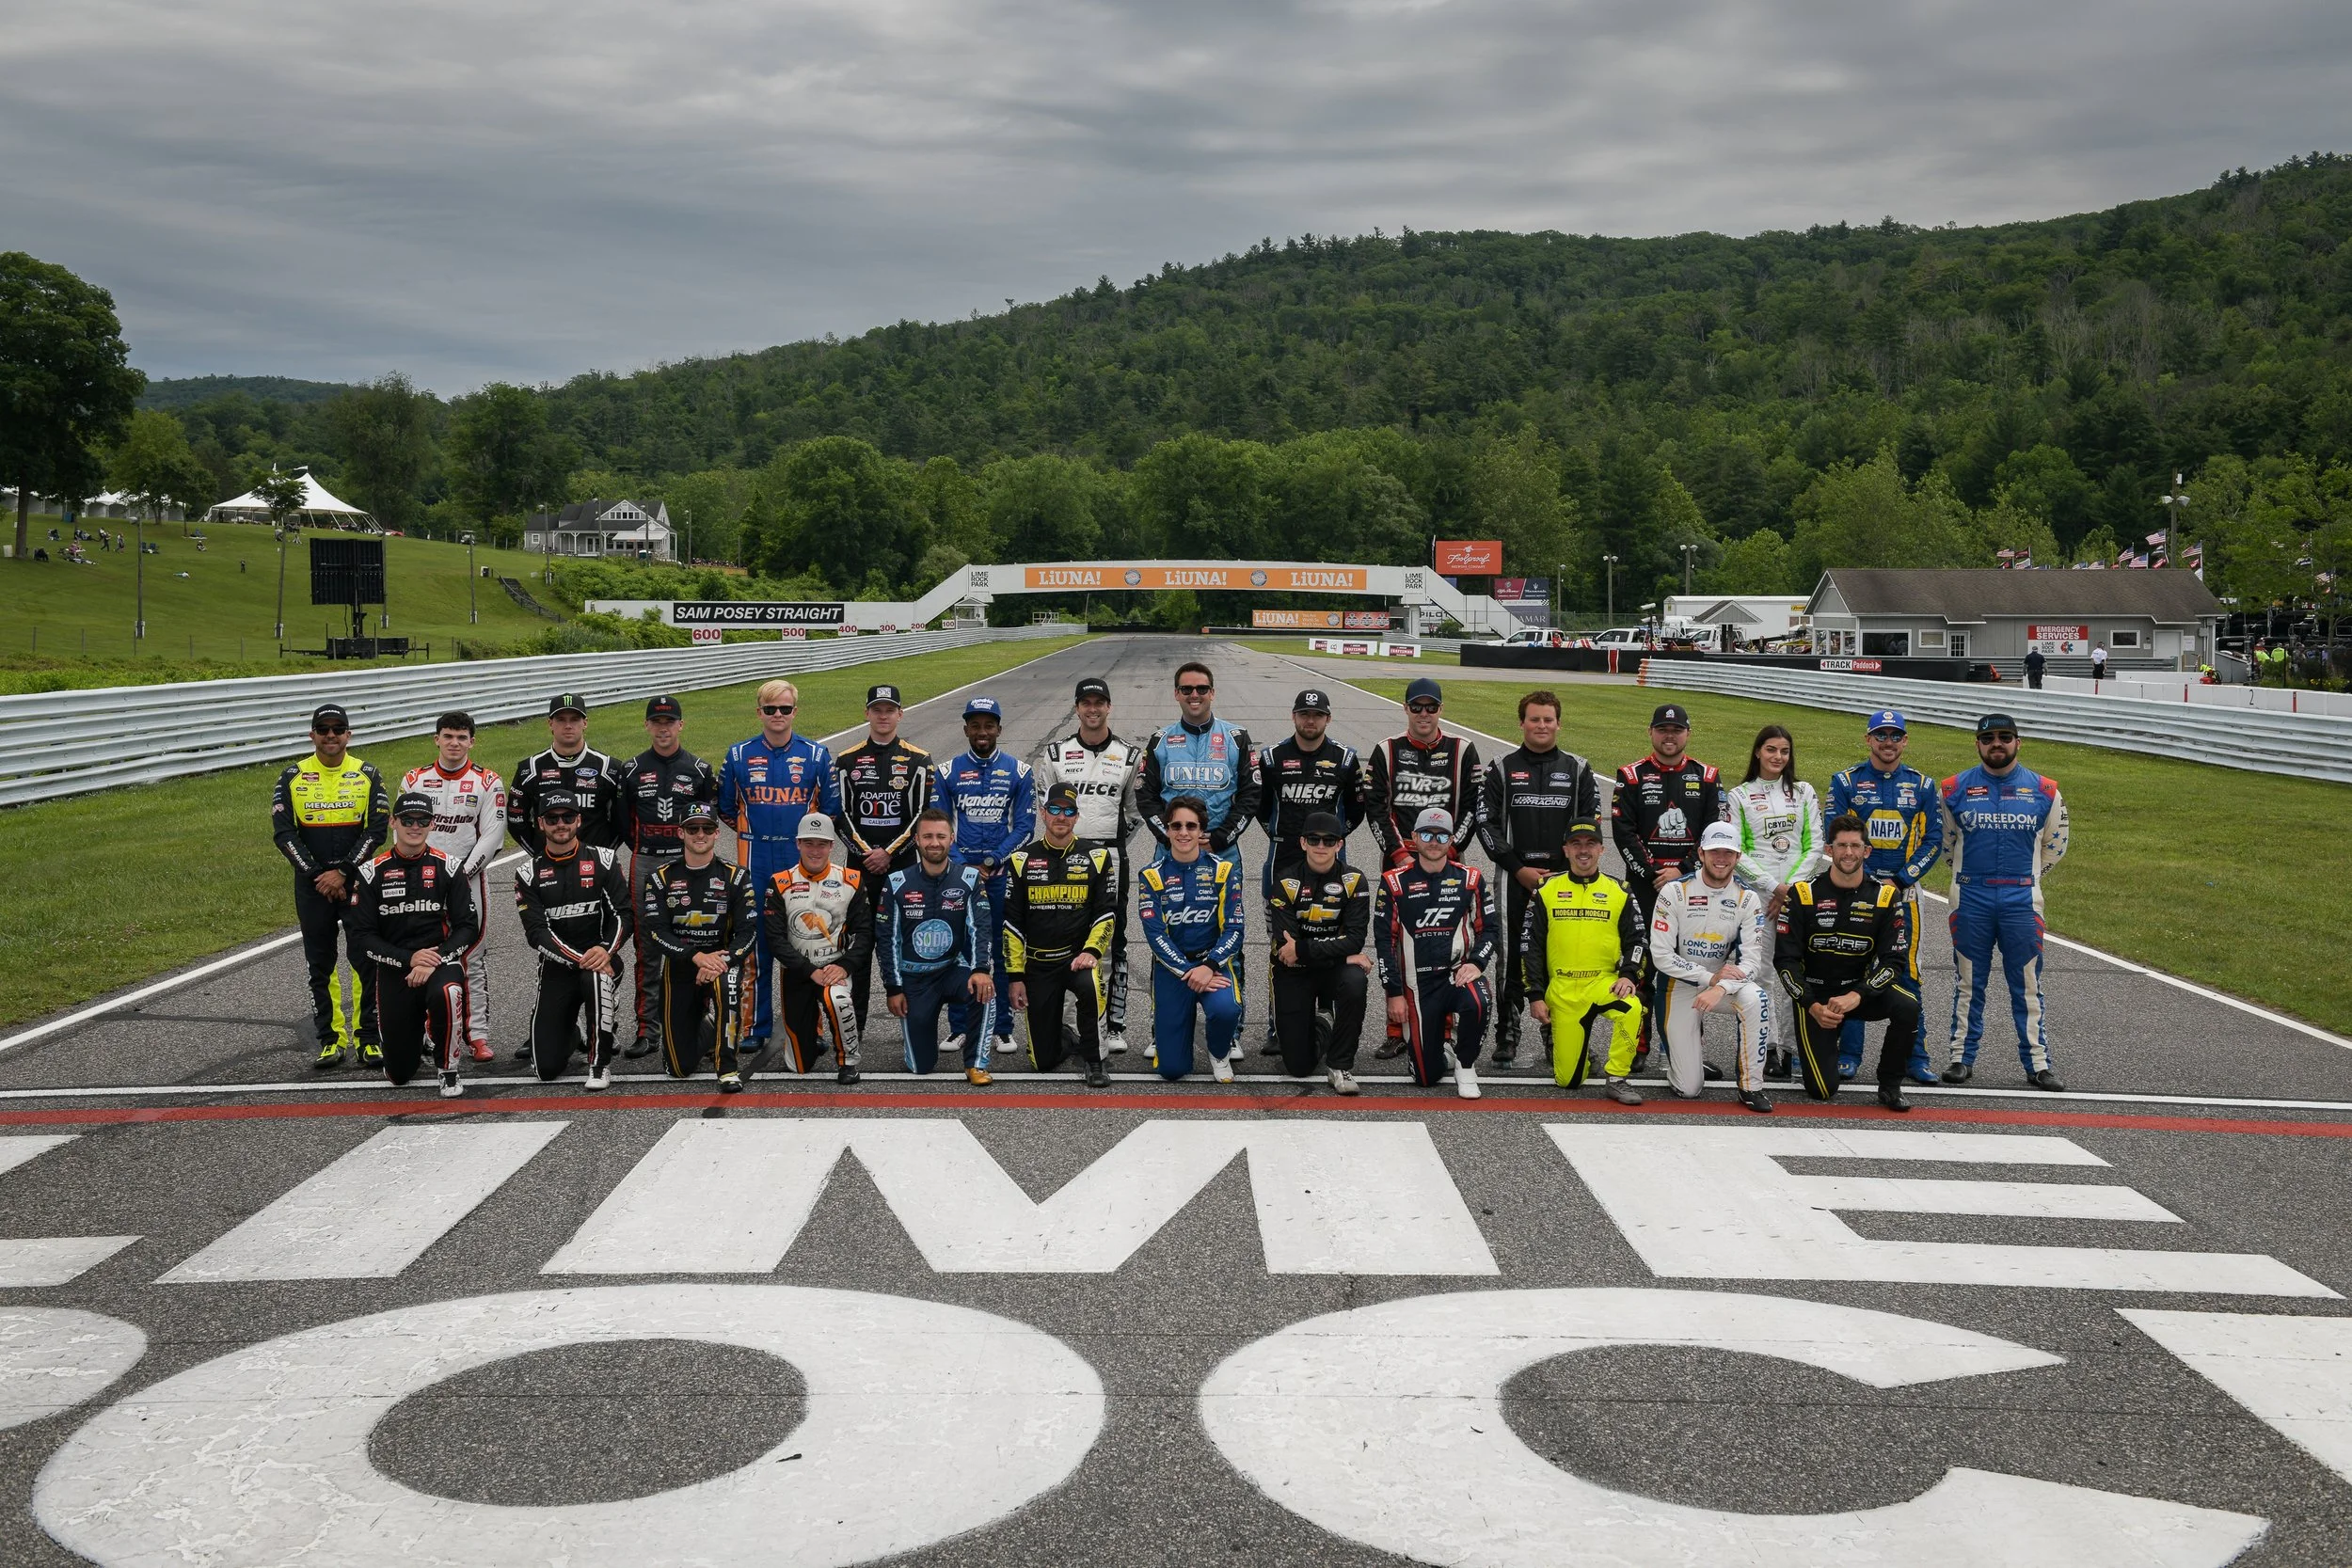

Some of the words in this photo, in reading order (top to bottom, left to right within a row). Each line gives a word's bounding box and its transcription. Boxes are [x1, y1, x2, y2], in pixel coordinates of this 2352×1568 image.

[1447, 554, 1490, 564] Foolproof
[1039, 571, 1101, 585] LiUNA!
[1165, 571, 1227, 586] LiUNA!
[1291, 572, 1353, 587] LiUNA!
[675, 607, 711, 619] SAM
[713, 607, 764, 620] POSEY
[765, 607, 842, 620] STRAIGHT
[1255, 612, 1299, 624] LiUNA!
[692, 629, 722, 641] 600
[782, 628, 805, 637] 500
[838, 625, 858, 634] 400
[2249, 689, 2254, 705] 2
[1169, 767, 1224, 782] UNITS
[1281, 784, 1337, 799] NIECE
[1411, 777, 1432, 792] VR
[546, 794, 572, 807] Tricon
[745, 785, 809, 802] LiUNA!
[860, 792, 901, 800] ADAPTIVE
[860, 800, 901, 816] one
[957, 794, 1010, 810] Hendrick
[433, 814, 453, 824] First
[453, 814, 474, 824] Auto
[966, 807, 1004, 817] Cars.com
[1978, 813, 2037, 825] FREEDOM
[1768, 821, 1786, 829] CBYD
[1871, 820, 1901, 838] NAPA
[287, 840, 310, 871] MENARDS
[1622, 847, 1646, 878] BRAWL
[1918, 857, 1931, 867] AUTO
[1028, 886, 1088, 900] CHAMPION
[379, 899, 441, 916] Safelite
[1723, 900, 1737, 908] Ford
[1166, 904, 1218, 925] telcel
[1585, 910, 1609, 919] MORGAN
[916, 931, 949, 947] SODA
[1683, 939, 1707, 949] LONG
[1813, 936, 1868, 948] SPIRE
[366, 950, 402, 968] Safelite
[1687, 948, 1725, 959] SILVER'S
[1110, 960, 1128, 1024] NIECE
[1756, 989, 1770, 1023] JOHN
[1757, 1028, 1768, 1064] LONG
[0, 1117, 2343, 1303] IME
[0, 1282, 2352, 1568] OC
